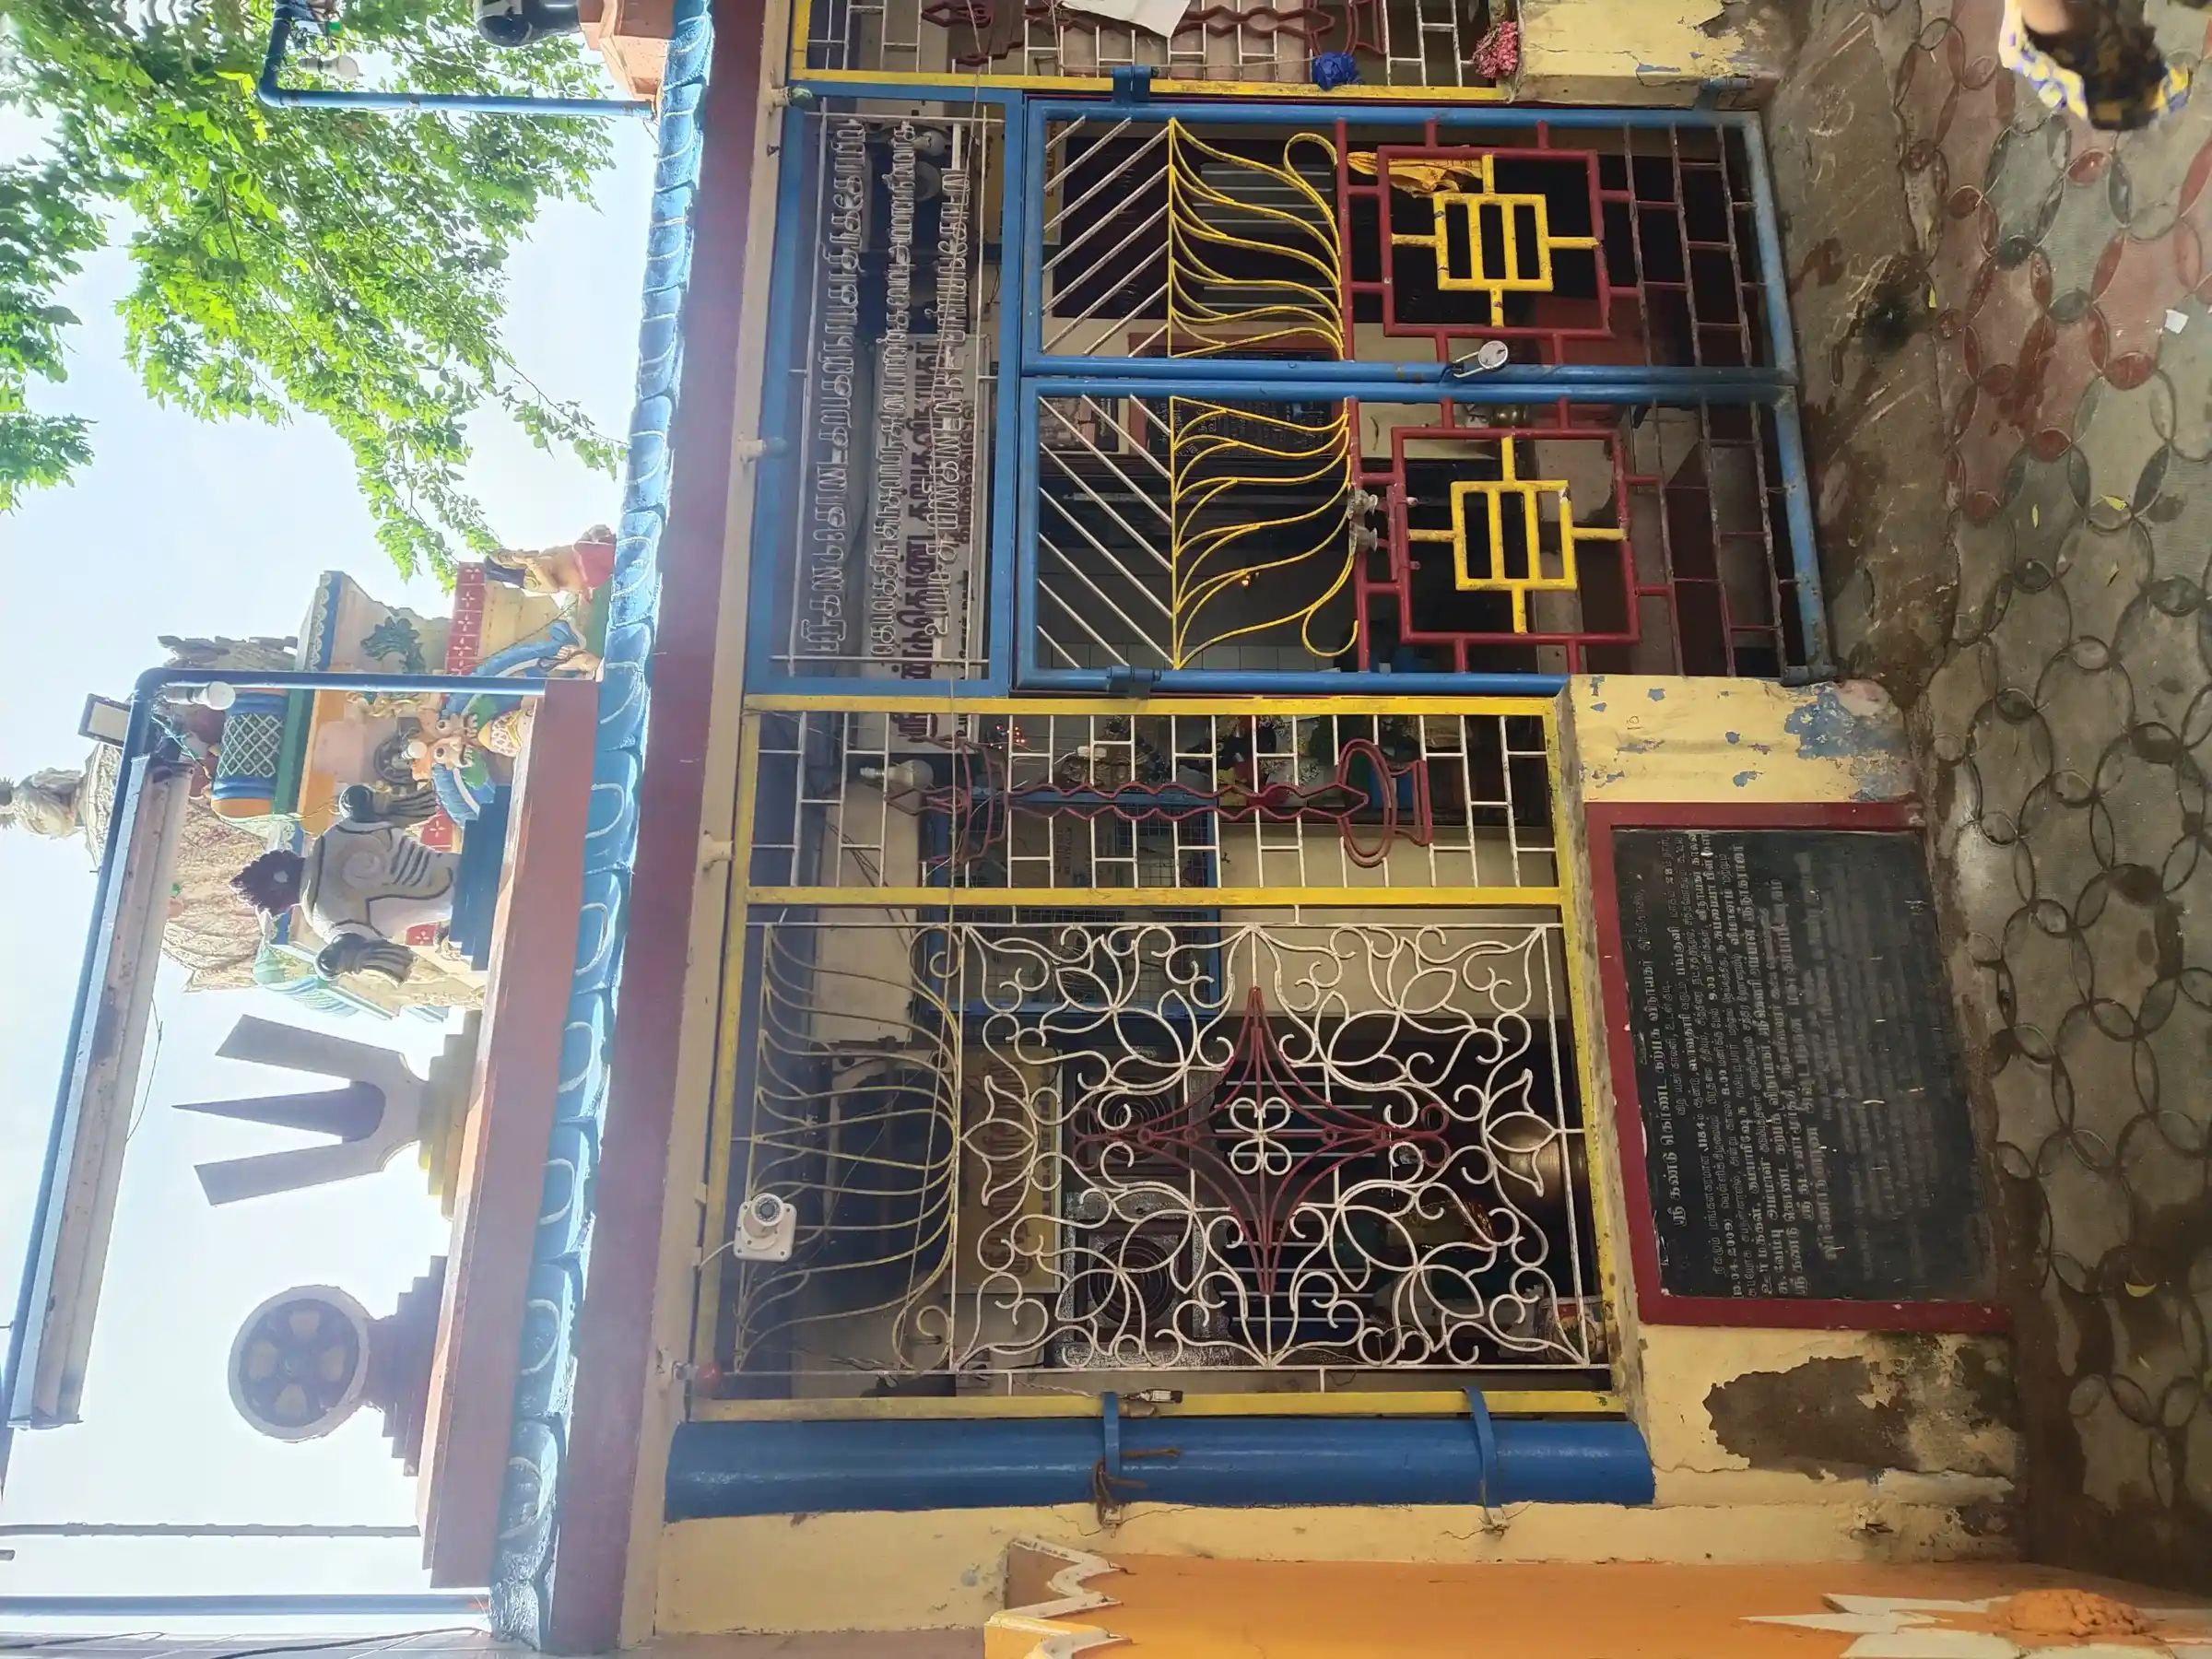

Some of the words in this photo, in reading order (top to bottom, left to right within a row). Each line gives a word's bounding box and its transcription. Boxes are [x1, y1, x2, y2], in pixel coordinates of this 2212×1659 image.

[1688, 870, 1712, 921] விநாயகர்
[1666, 926, 1686, 975] பங்குனி
[1640, 959, 1662, 1021] விநாயகர்
[1706, 976, 1718, 1001] 9.00
[1649, 1029, 1667, 1073] கற்பக
[1718, 1069, 1731, 1096] 8.00
[1653, 1077, 1676, 1146] கொண்ட
[1726, 1135, 1740, 1167] அன்று
[1663, 1151, 1681, 1200] கண்டு
[1667, 1206, 1687, 1227] ஸ்ரீ
[1708, 1237, 1727, 1275] நிகழும்
